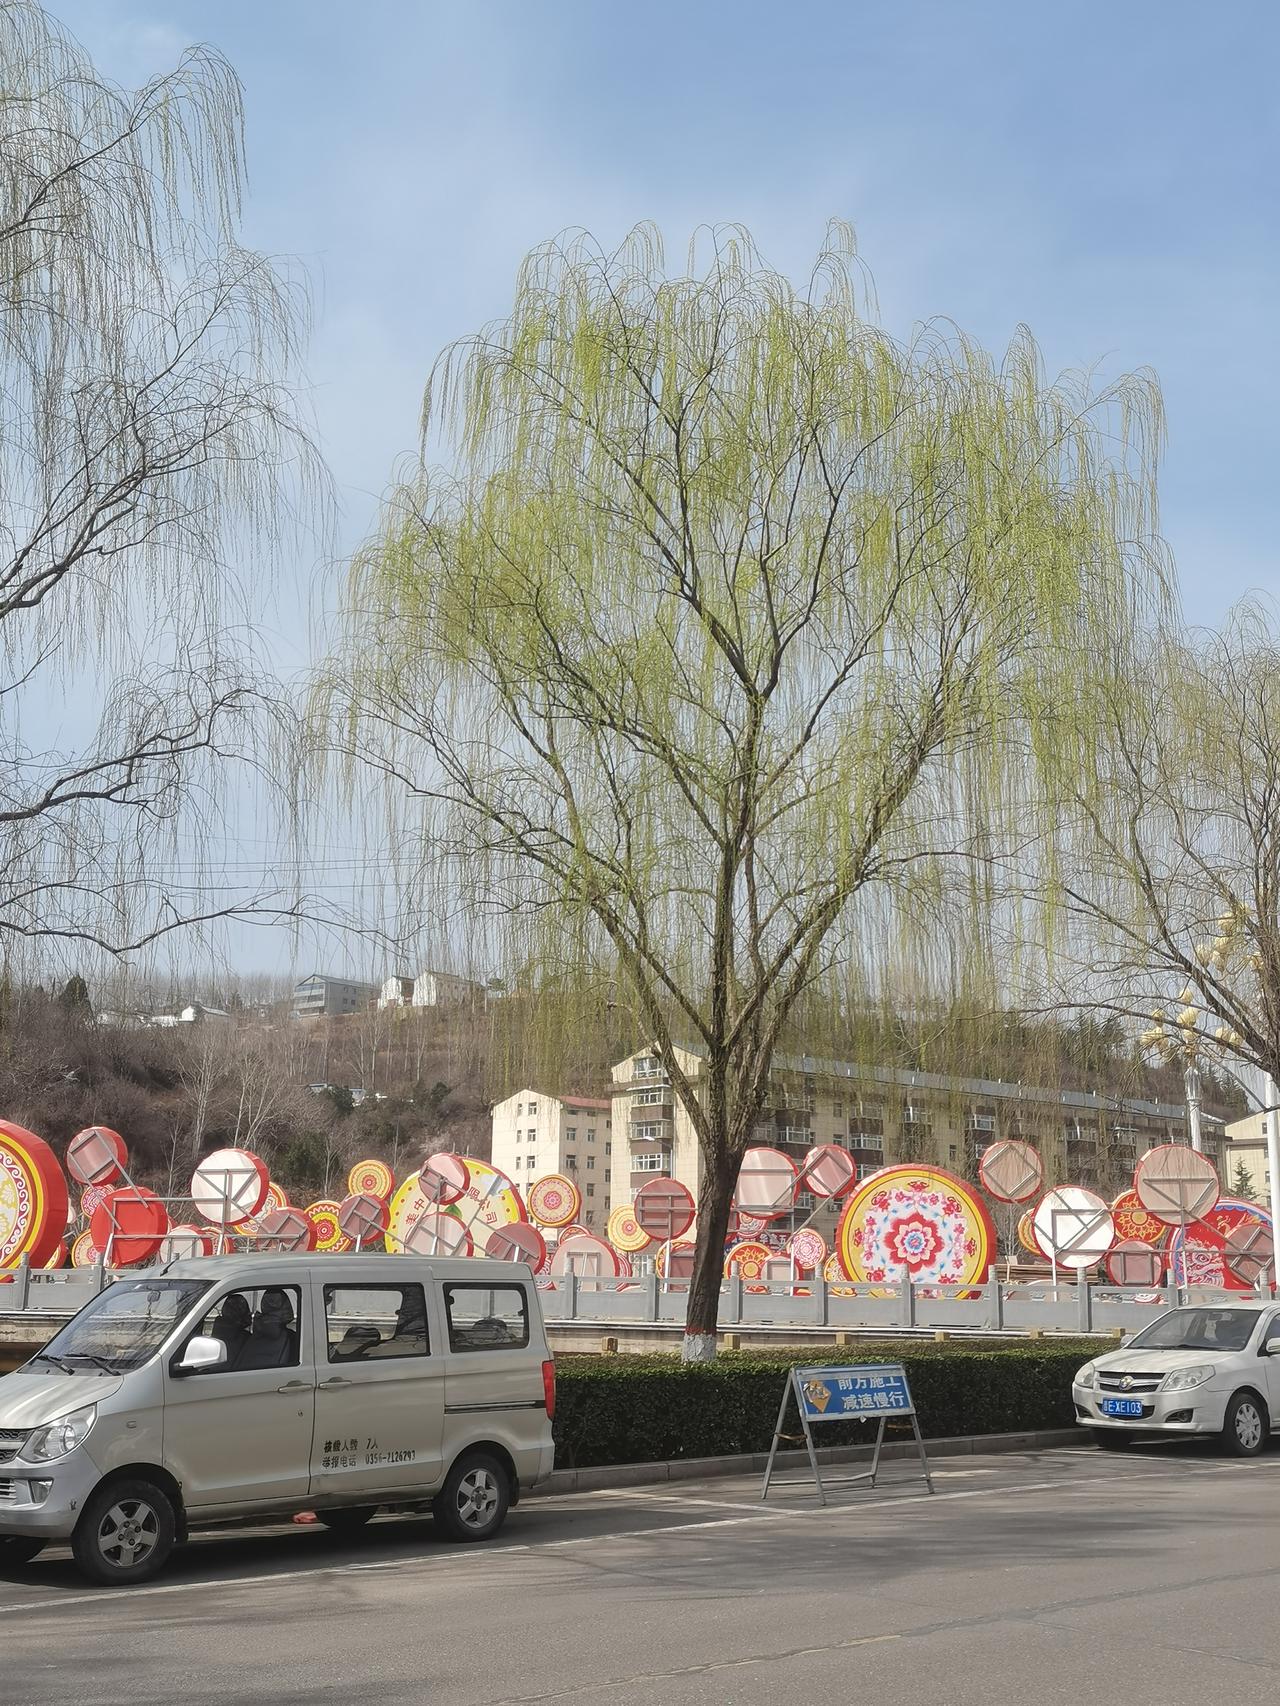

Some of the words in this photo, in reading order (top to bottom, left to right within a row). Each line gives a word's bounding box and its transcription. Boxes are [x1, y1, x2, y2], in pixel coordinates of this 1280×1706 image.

[838, 1376, 901, 1390] 前方施工
[841, 1391, 904, 1410] 减速慢行
[321, 1454, 357, 1470] 举报电话
